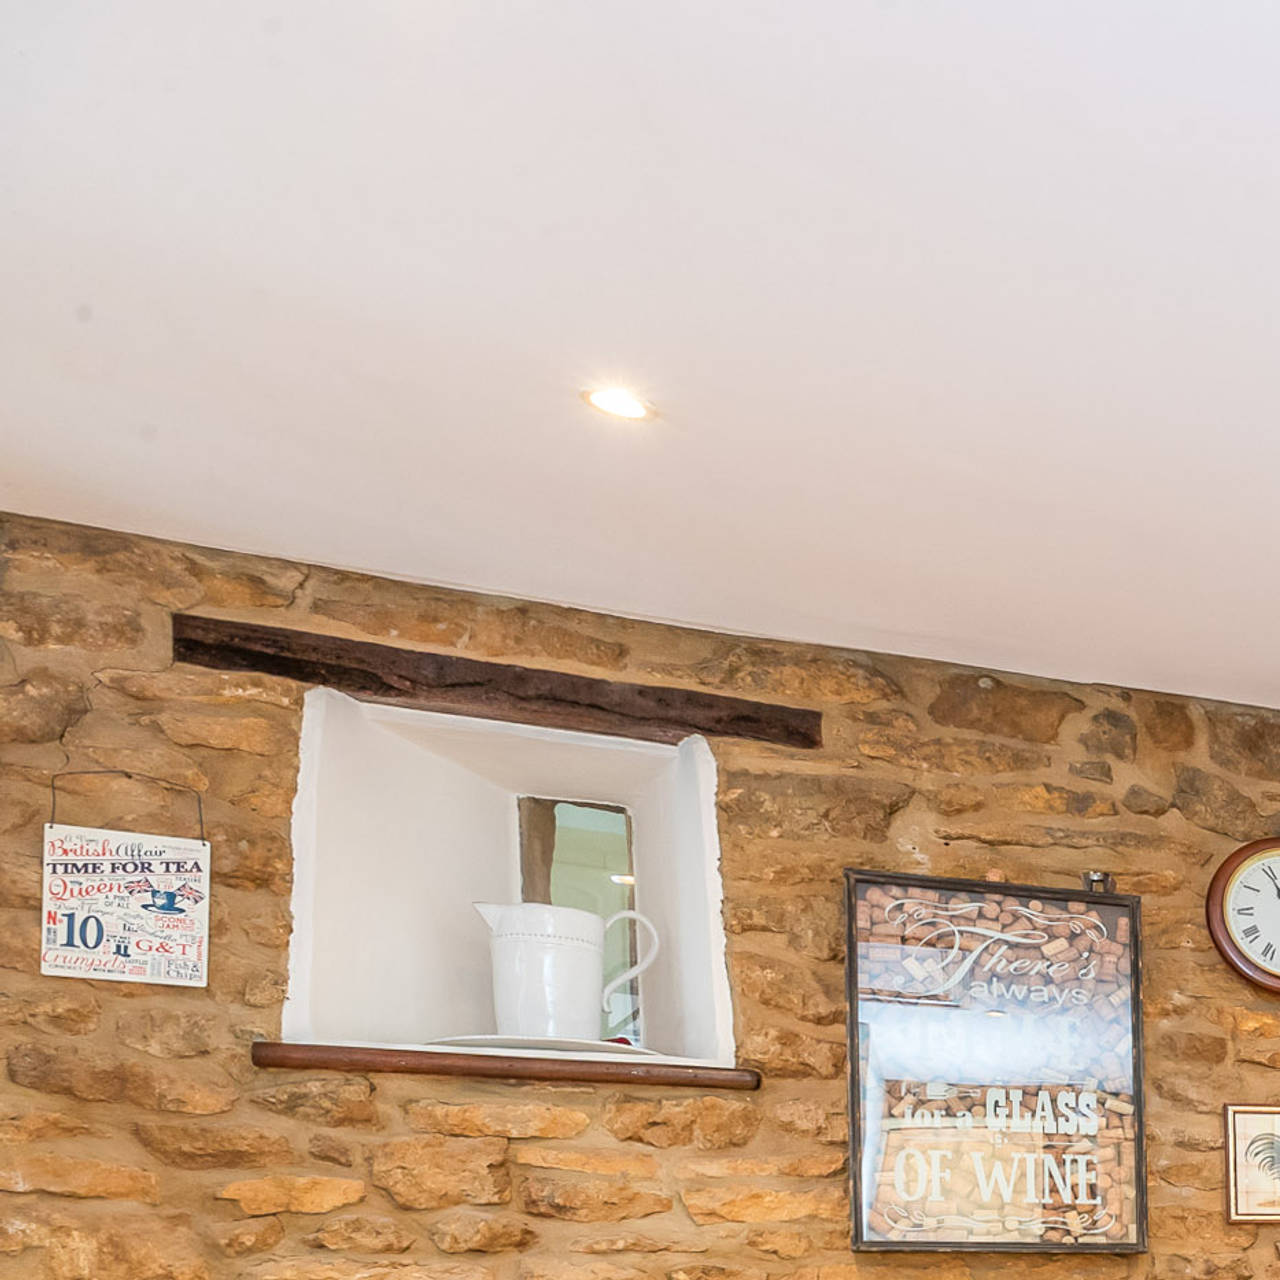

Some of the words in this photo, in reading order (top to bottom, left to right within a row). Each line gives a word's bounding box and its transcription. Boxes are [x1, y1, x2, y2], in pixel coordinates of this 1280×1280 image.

[48, 839, 114, 857] British
[115, 842, 166, 861] Affair
[46, 862, 105, 875] TIME
[110, 862, 155, 874] FOR
[160, 860, 203, 874] TEA
[48, 877, 127, 901] Queen
[59, 912, 104, 950] 10
[135, 939, 193, 956] G&T
[892, 918, 1097, 997] There's
[968, 977, 1088, 1007] always
[985, 1087, 1099, 1136] GLASS
[894, 1148, 952, 1201] OF
[970, 1150, 1102, 1206] WINE
